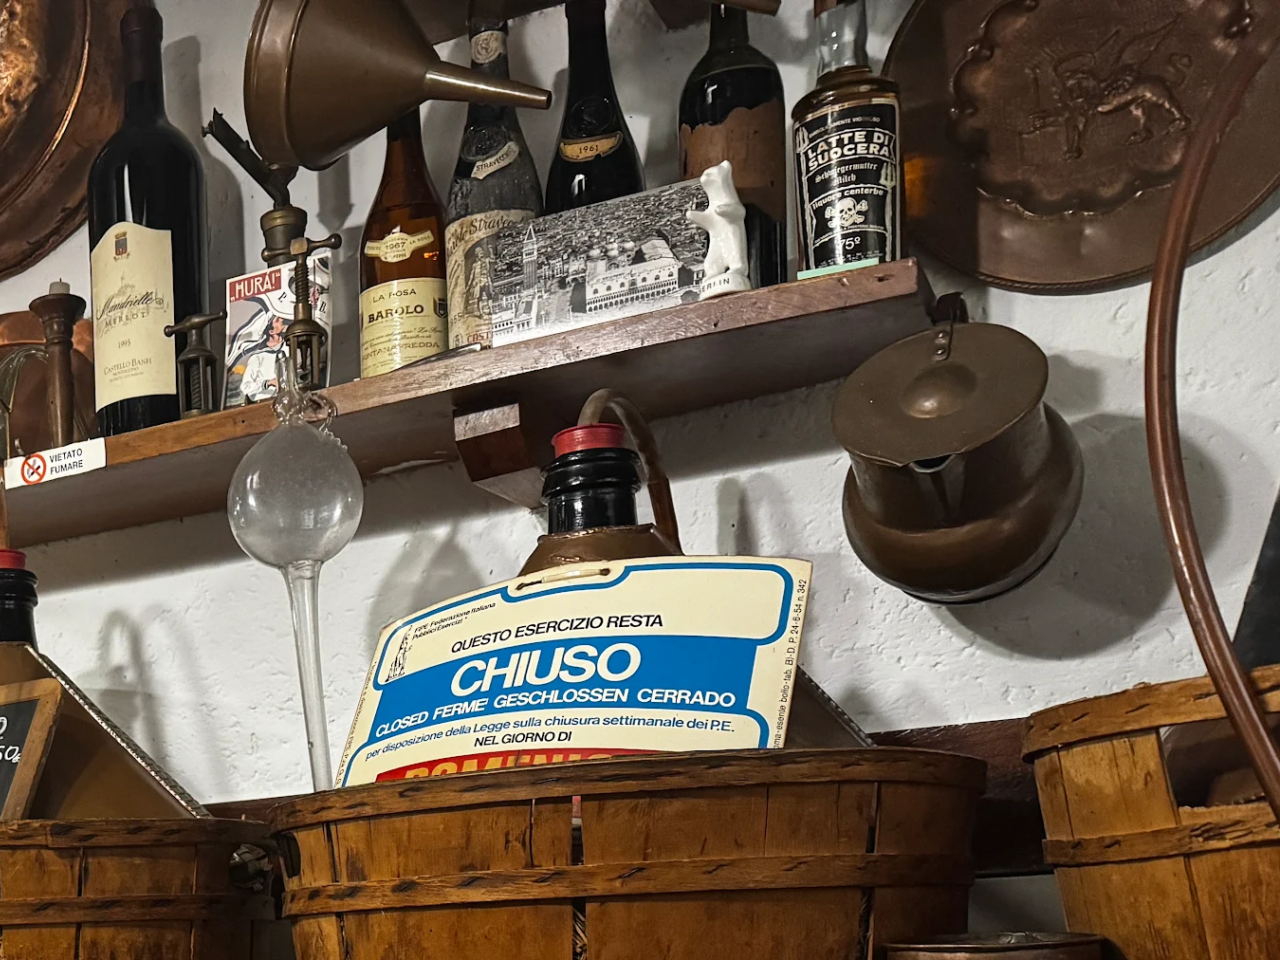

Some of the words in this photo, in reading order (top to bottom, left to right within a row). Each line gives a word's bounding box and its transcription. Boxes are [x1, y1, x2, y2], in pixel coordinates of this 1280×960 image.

[579, 144, 599, 154] 1961
[808, 131, 867, 159] LATTE
[873, 132, 889, 147] DI
[808, 143, 889, 171] SUOCERA
[812, 190, 842, 210] liquore
[844, 187, 884, 196] centerbe
[373, 294, 385, 303] LA
[105, 311, 148, 328] MERLOT
[368, 303, 425, 324] BAROLO
[49, 448, 83, 463] VIETATO
[50, 460, 84, 475] FUMARE
[797, 578, 808, 592] 342
[451, 629, 512, 654] QUESTO
[514, 616, 604, 638] ESERCIZIO
[606, 614, 664, 629] RESTA
[450, 642, 642, 697] CHIUSO
[375, 711, 429, 738] CLOSED
[493, 687, 629, 709] GESCHLOSSEN
[637, 688, 736, 707] CERRADO
[365, 748, 381, 762] per
[381, 732, 444, 753] disposizione
[444, 725, 471, 738] della
[473, 718, 511, 734] Legge
[512, 715, 542, 728] sulla
[544, 714, 600, 726] chiusura
[602, 715, 684, 728] settimanale
[686, 718, 708, 730] dei
[709, 720, 735, 733] P.E.
[474, 736, 500, 748] NEL
[501, 731, 555, 745] GIORNO
[557, 731, 573, 742] DI
